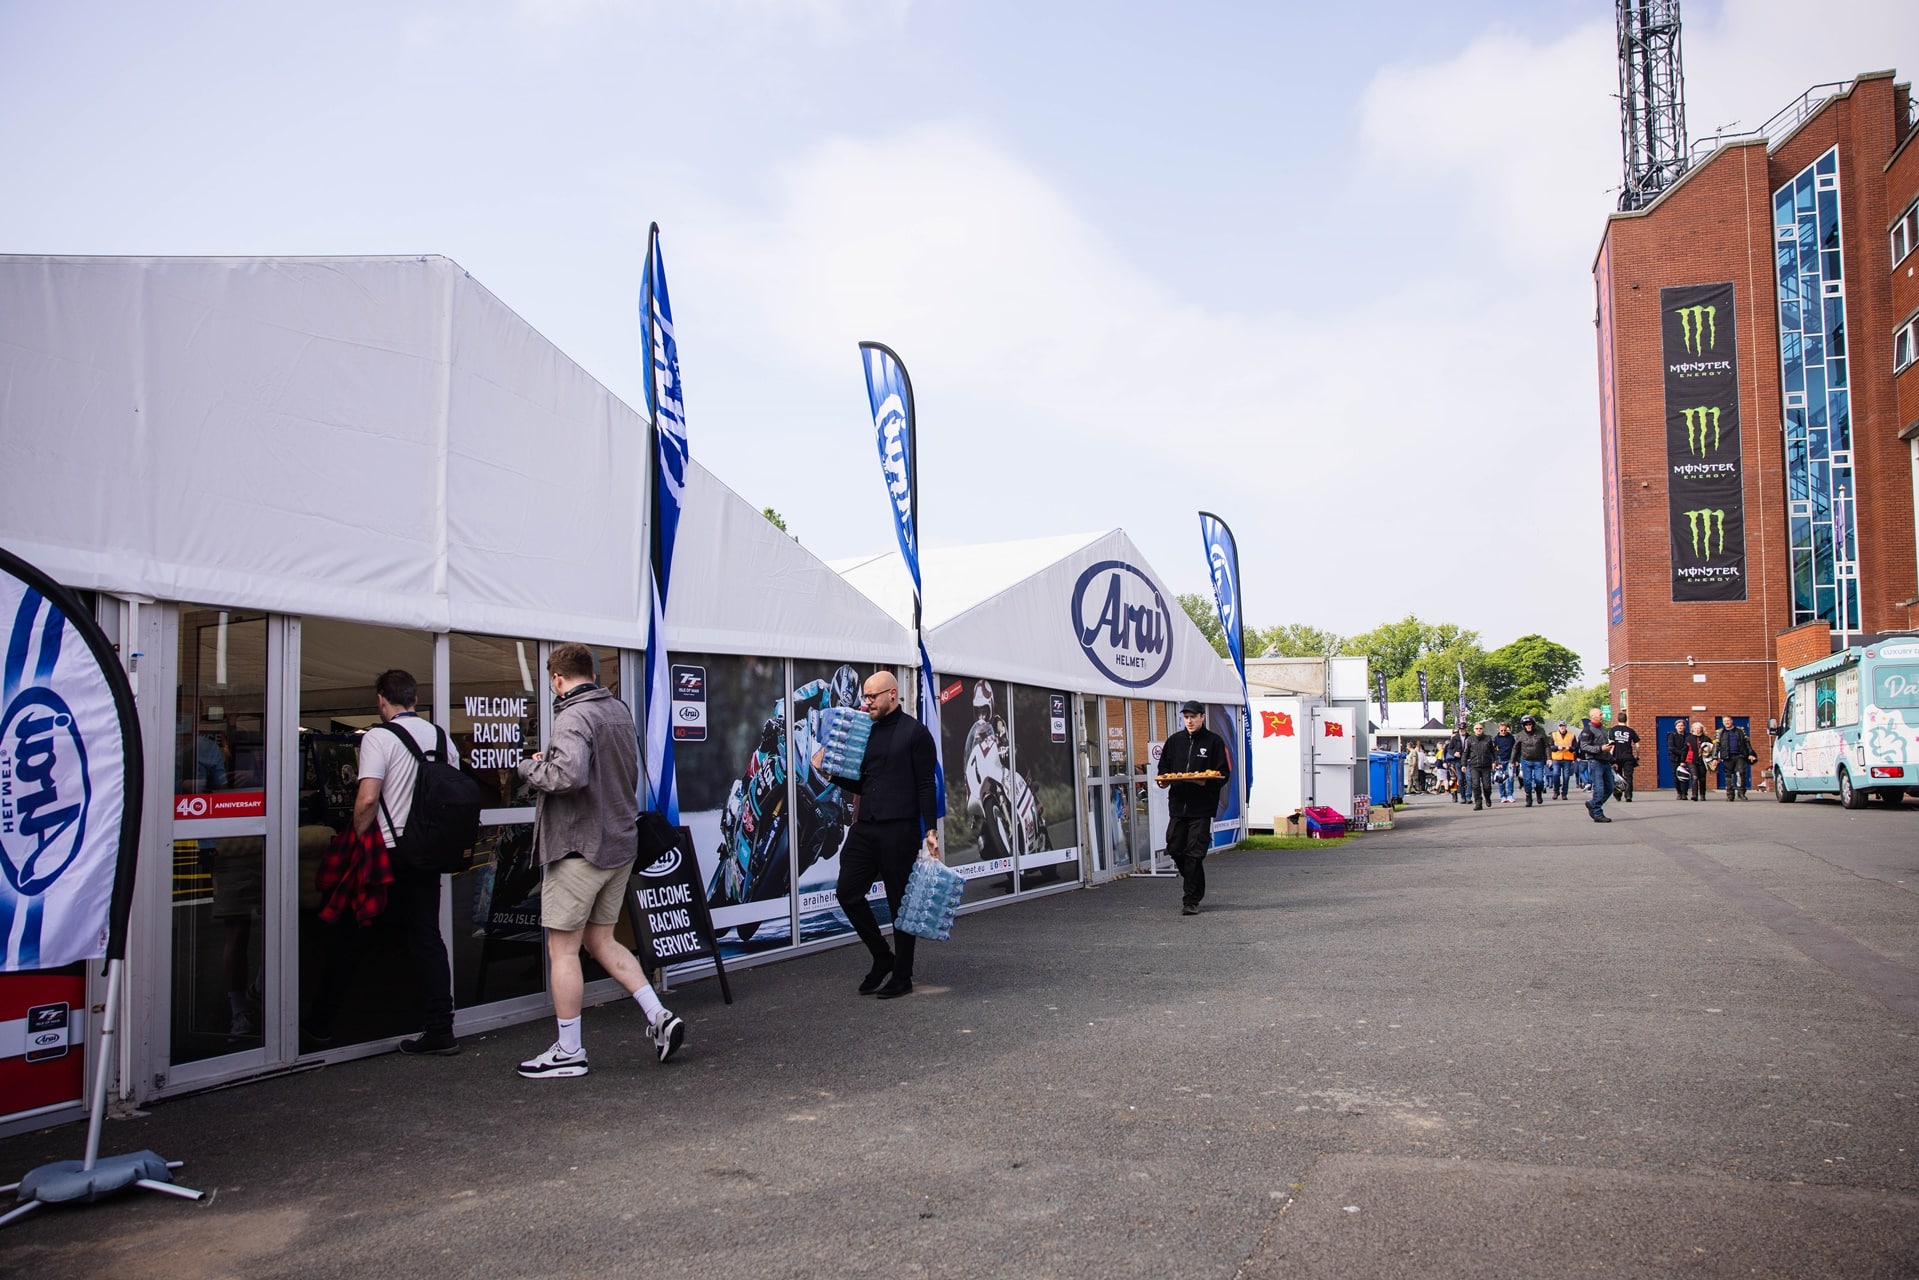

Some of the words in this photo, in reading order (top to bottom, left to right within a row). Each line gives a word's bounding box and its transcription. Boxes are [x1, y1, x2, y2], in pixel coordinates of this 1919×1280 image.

[1670, 361, 1731, 373] MONSTER
[1674, 463, 1736, 474] MONSTER
[1678, 566, 1740, 577] MONSTER
[1082, 572, 1164, 655] Arai
[1116, 654, 1144, 668] HELMET
[464, 696, 528, 718] WELCOME
[474, 722, 520, 743] RACING
[471, 748, 524, 768] SERVICE
[176, 798, 207, 816] 40
[636, 883, 692, 910] WELCOME
[492, 912, 514, 924] 2024
[515, 914, 536, 925] ISLE
[648, 908, 690, 933] RACING
[652, 931, 701, 958] SERVICE
